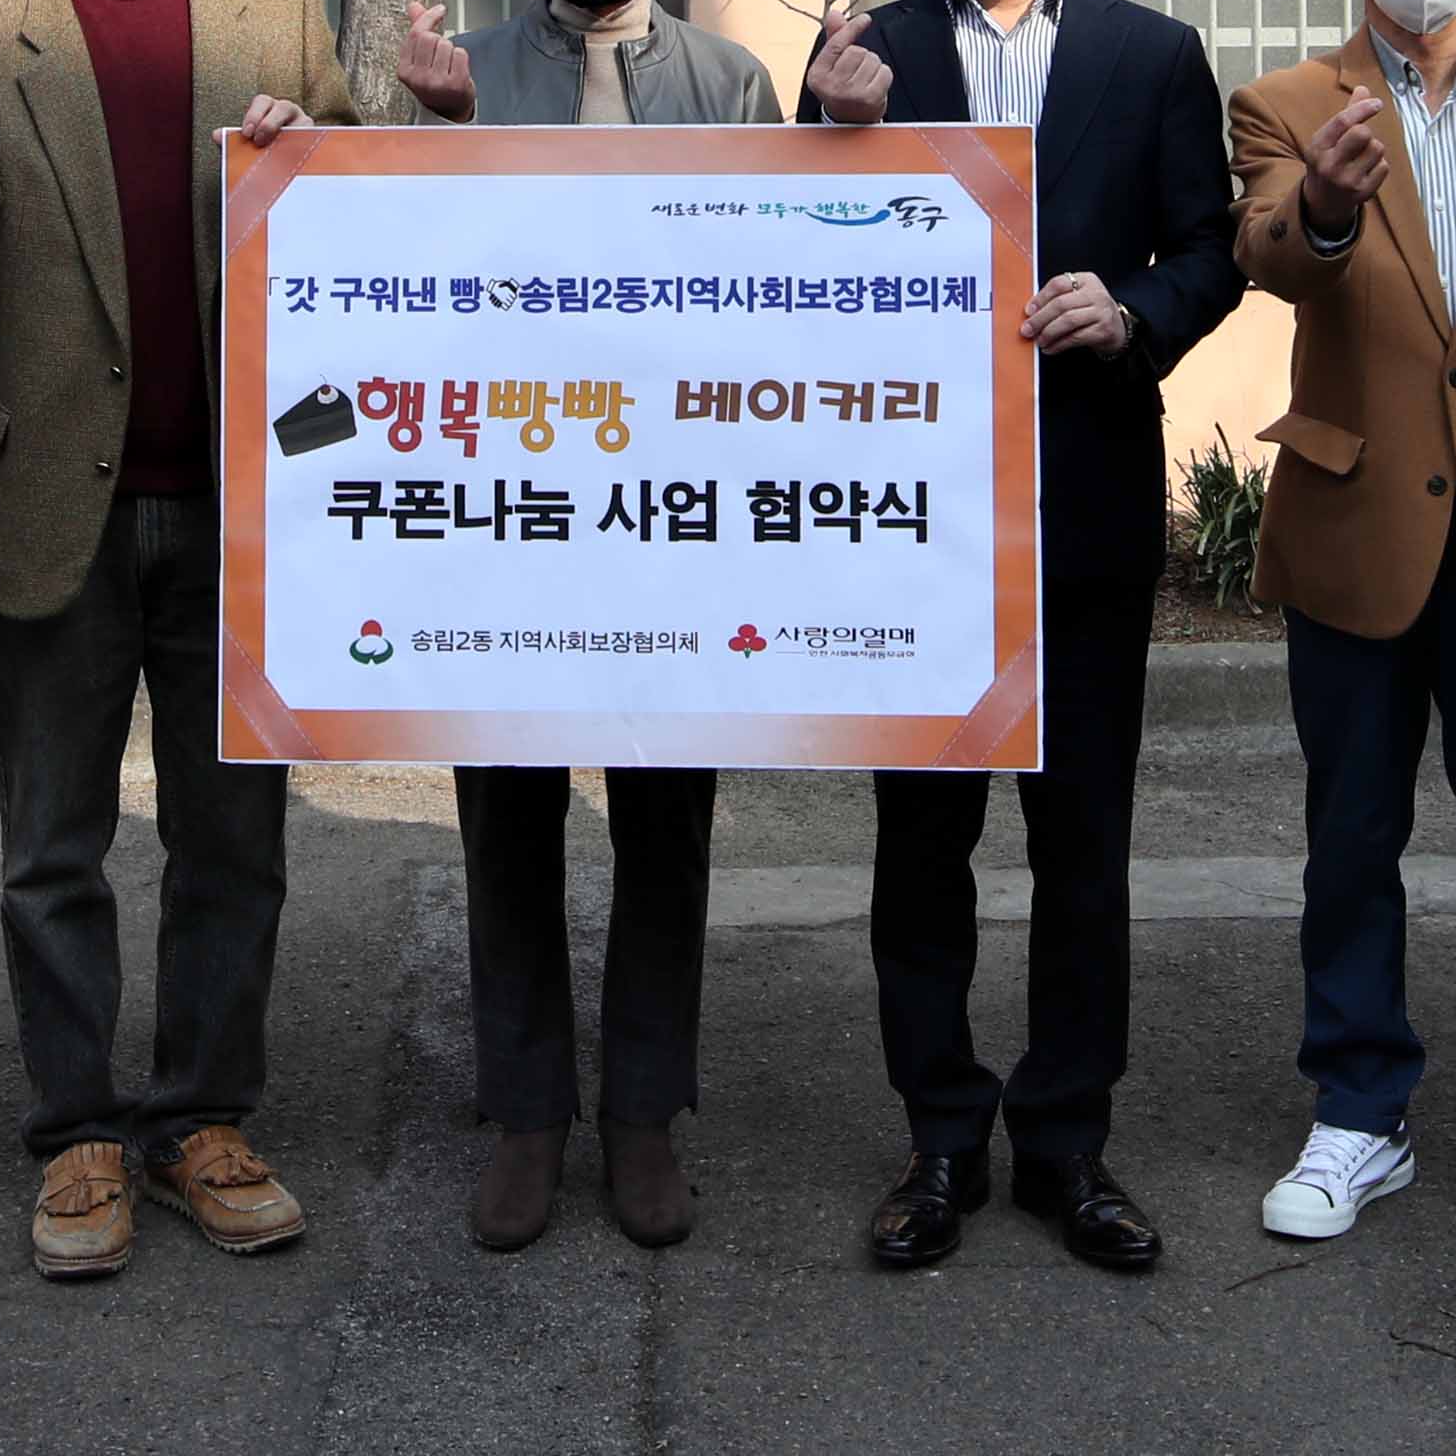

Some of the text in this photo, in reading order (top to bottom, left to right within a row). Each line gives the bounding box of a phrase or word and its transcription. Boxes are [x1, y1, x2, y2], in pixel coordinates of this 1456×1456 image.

[650, 201, 702, 217] 새로운
[704, 201, 749, 217] 변화
[329, 276, 437, 313] 구워낸
[449, 276, 485, 313] 빵
[357, 376, 941, 458] 행복빵빵 베이커리
[327, 479, 929, 544] 쿠폰나눔 사업 협약식
[411, 628, 700, 655] 송림2동 지역사회보장협의체
[774, 626, 916, 649] 사랑의열매
